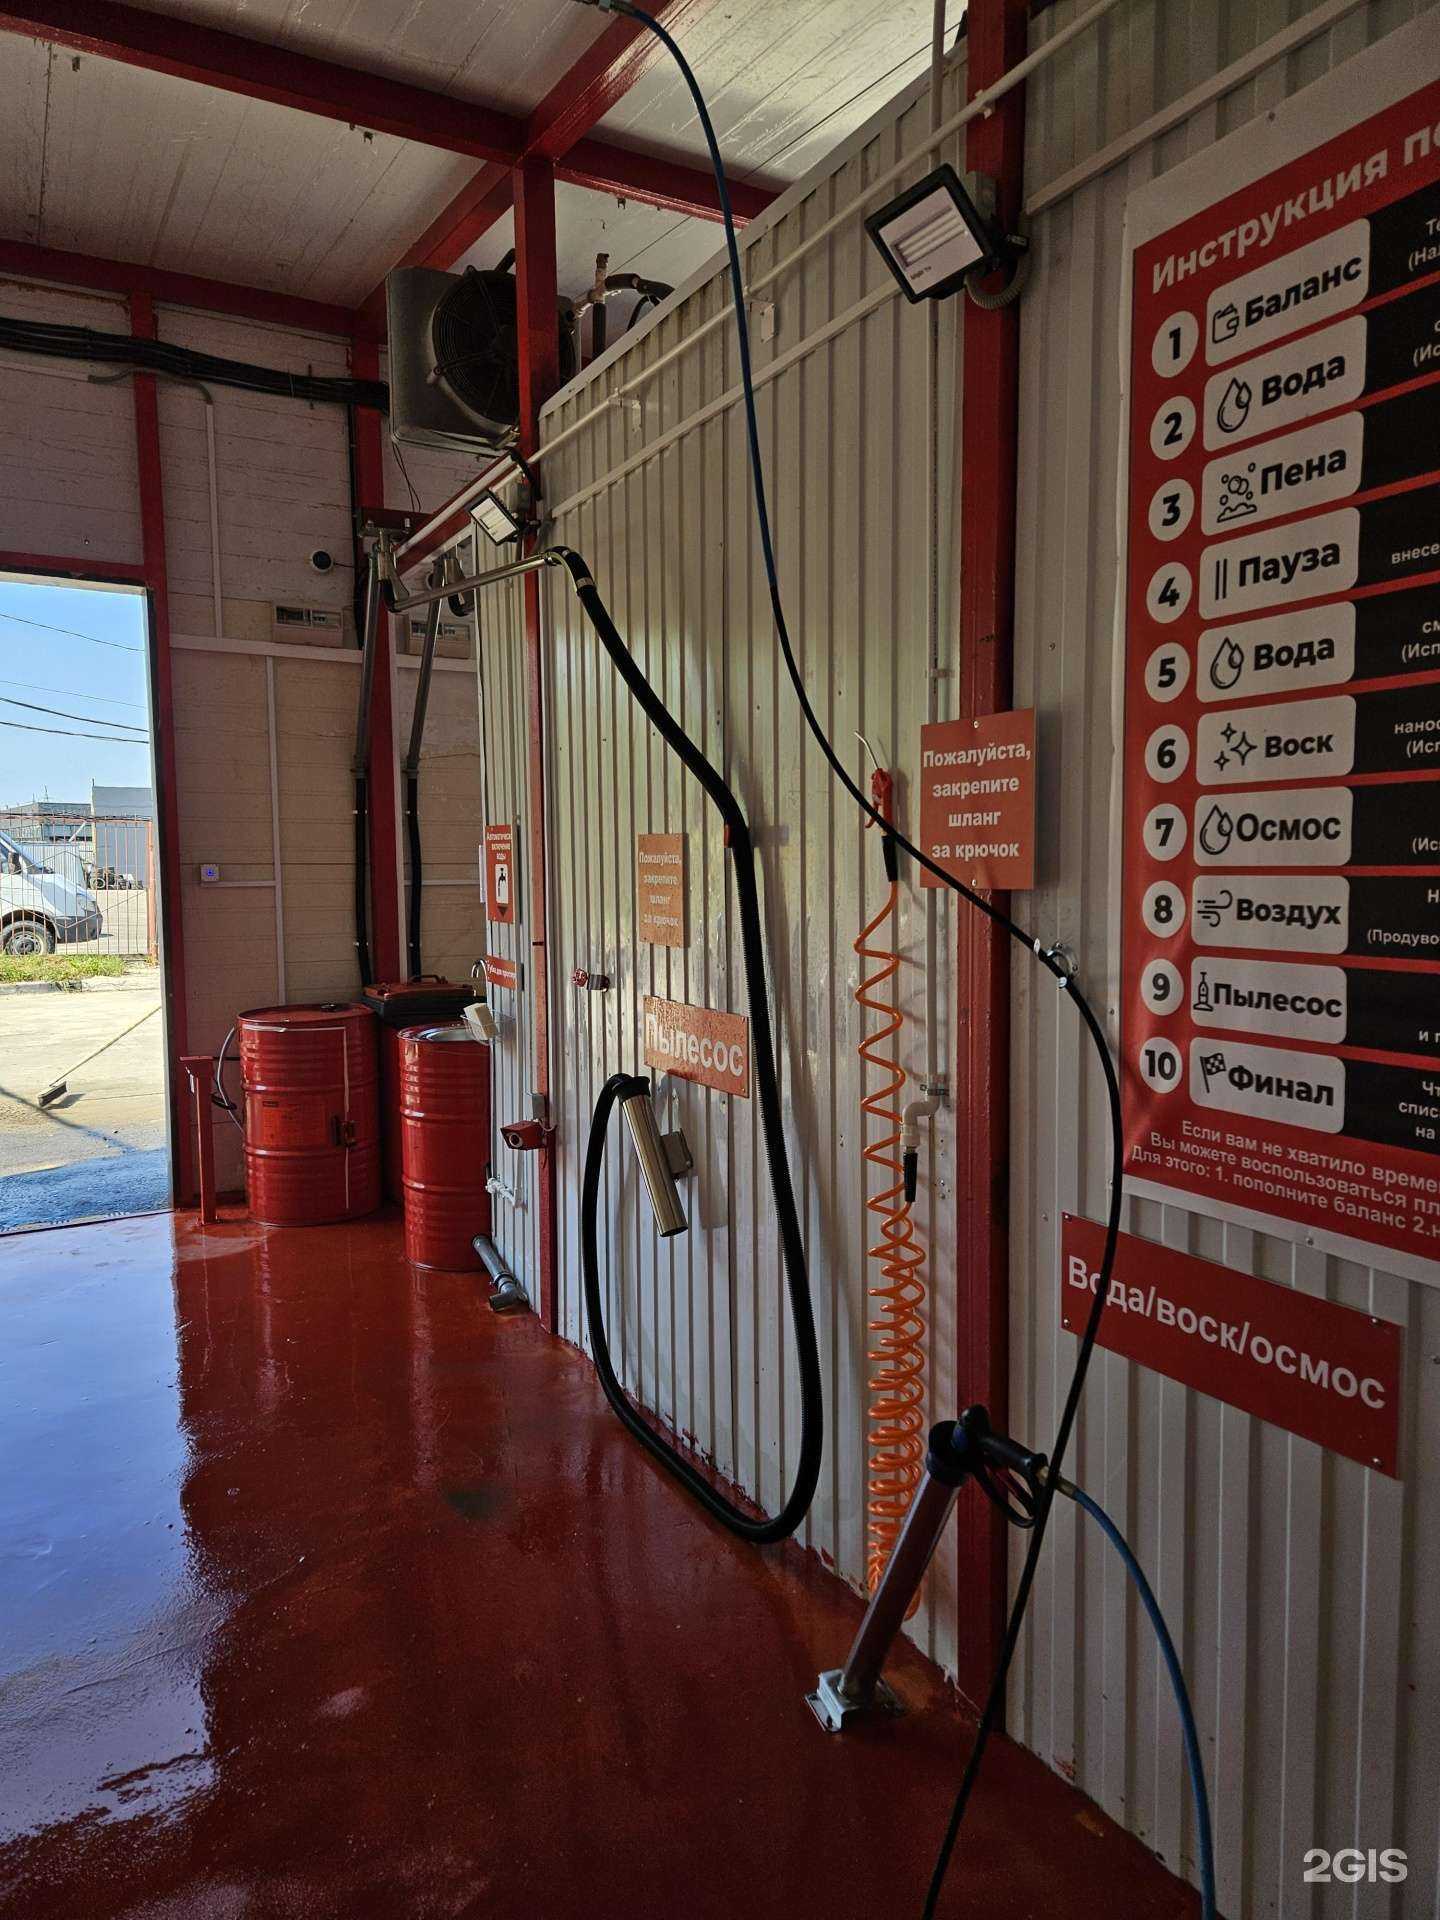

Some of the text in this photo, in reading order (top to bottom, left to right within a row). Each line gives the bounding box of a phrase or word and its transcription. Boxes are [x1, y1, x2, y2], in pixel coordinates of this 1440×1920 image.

[1151, 120, 1440, 294] Инструкция п
[1408, 245, 1440, 271] (На
[1245, 256, 1362, 328] Баланс
[1168, 327, 1182, 360] 1
[1261, 355, 1346, 406] Вода
[1163, 411, 1183, 446] 2
[1260, 449, 1347, 495] Пена
[1161, 492, 1181, 527] 3
[1238, 542, 1341, 594] Пауза
[1391, 543, 1440, 565] внесе
[1158, 577, 1180, 607] 4
[1253, 638, 1336, 671] Вода
[1157, 656, 1177, 688] 5
[923, 742, 1032, 768] Пожалуйста,
[1156, 738, 1177, 769] 6
[1264, 734, 1335, 758] Воск
[932, 776, 1020, 799] закрепите
[948, 810, 1002, 827] шланг
[1155, 818, 1175, 846] 7
[1235, 813, 1343, 843] Осмос
[931, 842, 1019, 861] за крючок
[1411, 837, 1440, 854] (Ис
[1153, 894, 1173, 924] 8
[1236, 898, 1341, 930] Воздух
[1367, 928, 1440, 947] (Продуво
[1152, 973, 1172, 1002] 9
[1213, 983, 1342, 1018] Пылесос
[646, 1012, 744, 1077] Пылесос
[1145, 1050, 1177, 1081] 10
[1227, 1064, 1334, 1107] Финал
[1398, 1101, 1440, 1118] спис
[1415, 1126, 1435, 1140] на
[1151, 1131, 1175, 1150] Вы
[1180, 1140, 1236, 1165] можете
[1241, 1157, 1407, 1208] воспользоваться
[1182, 1119, 1440, 1194] Если вам не хватило време
[1131, 1145, 1161, 1164] Для
[1165, 1156, 1211, 1177] этого:
[1232, 1173, 1329, 1209] пополните
[1333, 1196, 1407, 1229] баланс
